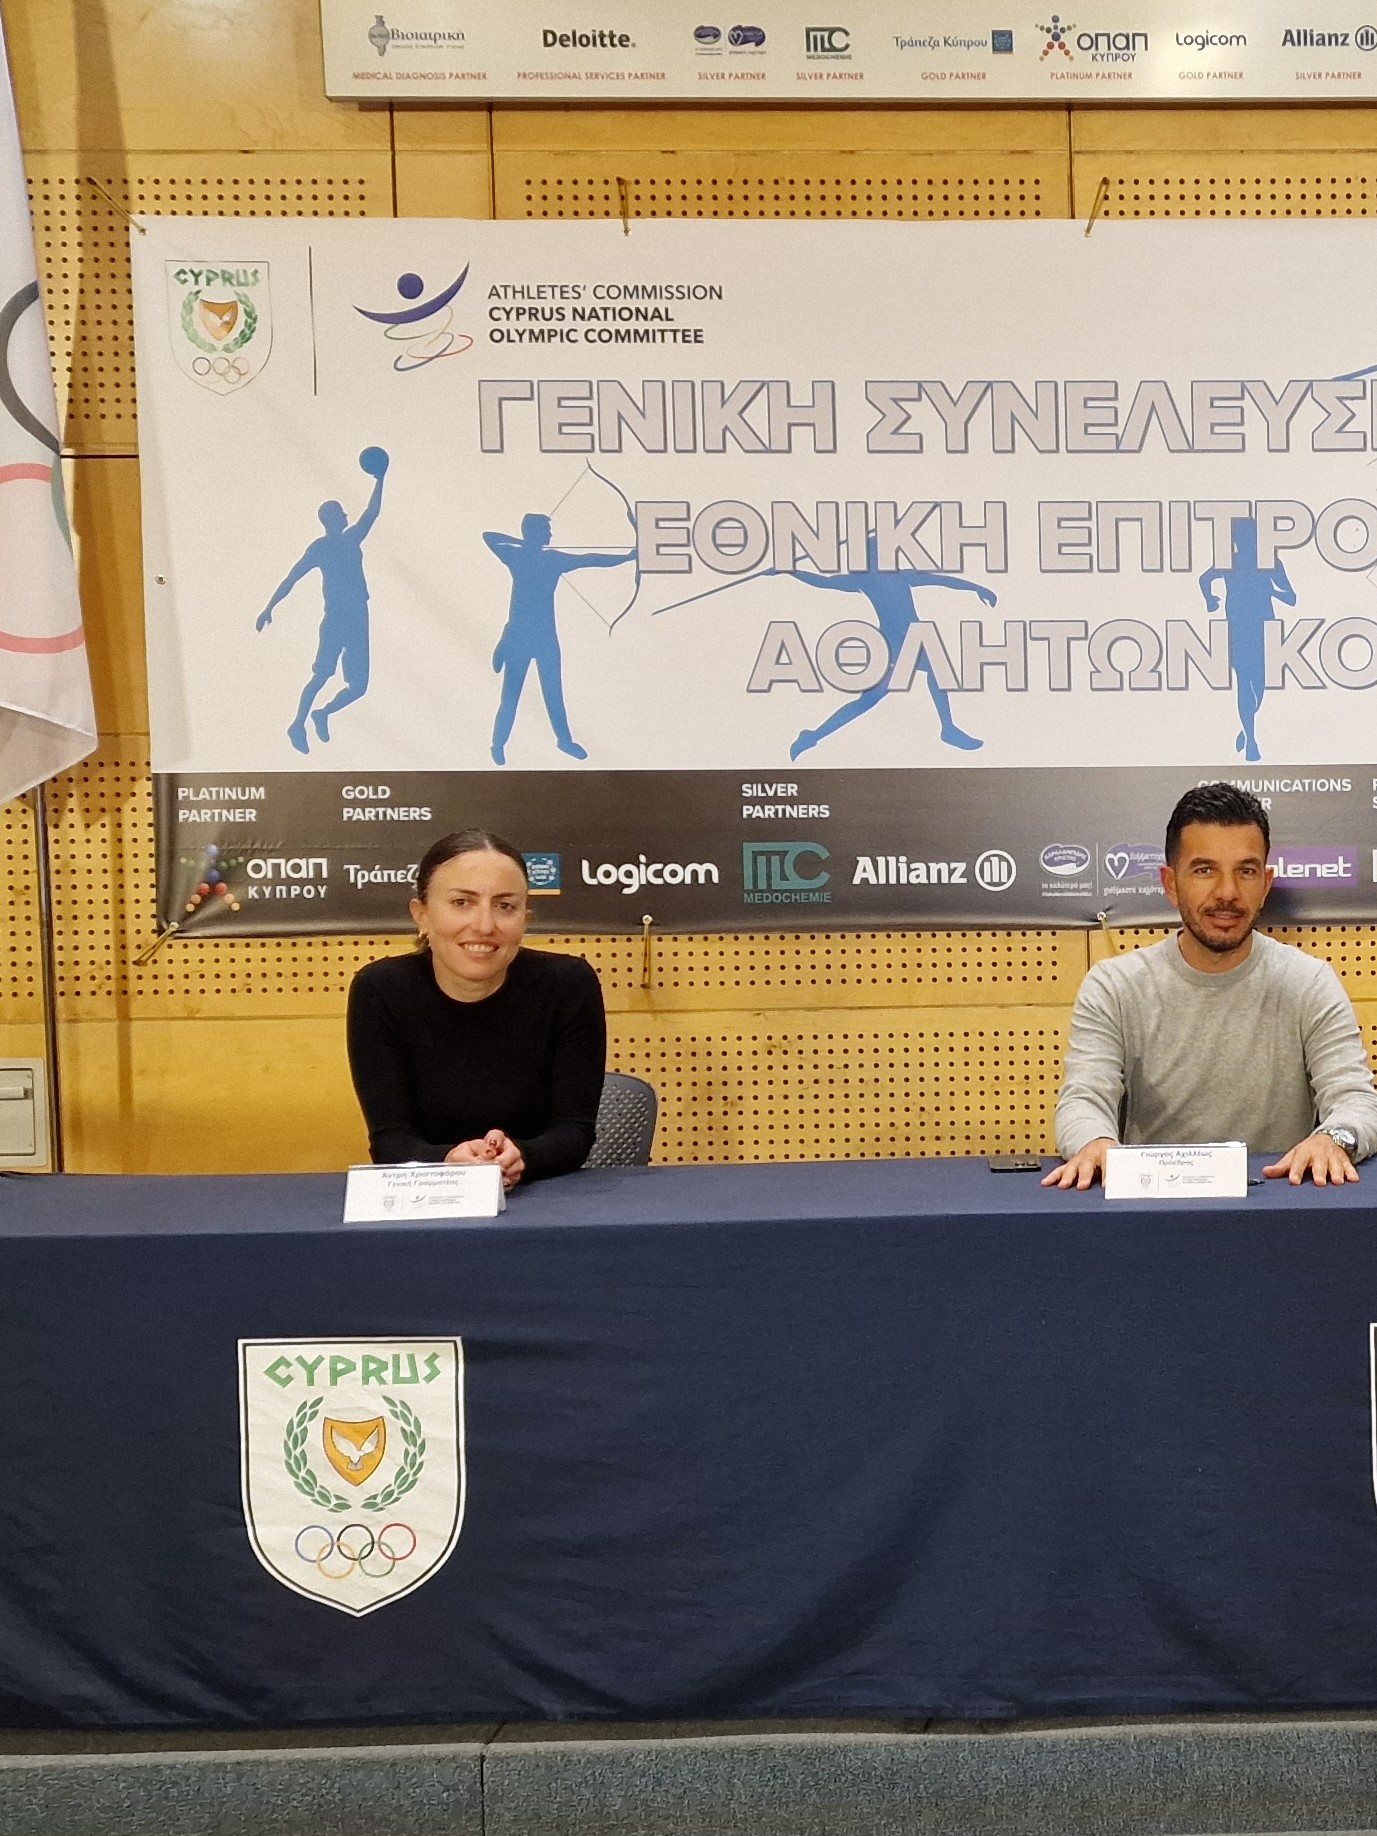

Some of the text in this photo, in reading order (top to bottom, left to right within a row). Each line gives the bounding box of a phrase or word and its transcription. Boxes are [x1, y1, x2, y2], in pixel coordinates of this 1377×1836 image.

[893, 36, 988, 50] Τράπεζα Κύπρου
[1281, 28, 1350, 47] Allianz
[1091, 53, 1137, 62] ΚΥΠΡΟΥ
[352, 71, 487, 80] MEDICAL DIAGNOSIS PARTNER
[516, 71, 666, 81] PROFESSIONAL SERVICES PARTNER
[698, 71, 767, 81] SILVER PARTNER
[796, 71, 865, 81] SILVER PARTNER
[920, 71, 988, 81] GOLD PARTNER
[1050, 71, 1133, 80] PLATINUM PARTNER
[1178, 71, 1244, 80] GOLD PARTNER
[1295, 71, 1363, 80] SILVER PARTNER
[172, 268, 260, 287] CYPRUS
[592, 284, 723, 300] COMMISSION
[488, 306, 675, 322] CYPRUS NATIONAL
[489, 327, 705, 344] OLYMPIC COMMITTEE
[478, 380, 837, 454] ΓΕΝΙΚΗ
[634, 500, 1008, 574] ΕΘΝΙΚΗ
[746, 618, 1233, 693] ΑΘΛΗΤΩΝ
[177, 786, 265, 801] PLATINUM
[341, 785, 391, 800] GOLD
[741, 783, 798, 797] SILVER
[178, 808, 257, 823] PARTNER
[342, 806, 432, 821] PARTNERS
[742, 804, 831, 819] PARTNERS
[343, 864, 420, 890] Τράπεζ
[852, 856, 968, 886] Allianz
[248, 885, 328, 900] ΚΥΠΡΟΥ
[743, 892, 832, 903] MEDOCHEMIE
[263, 1351, 442, 1389] CYPRUS
